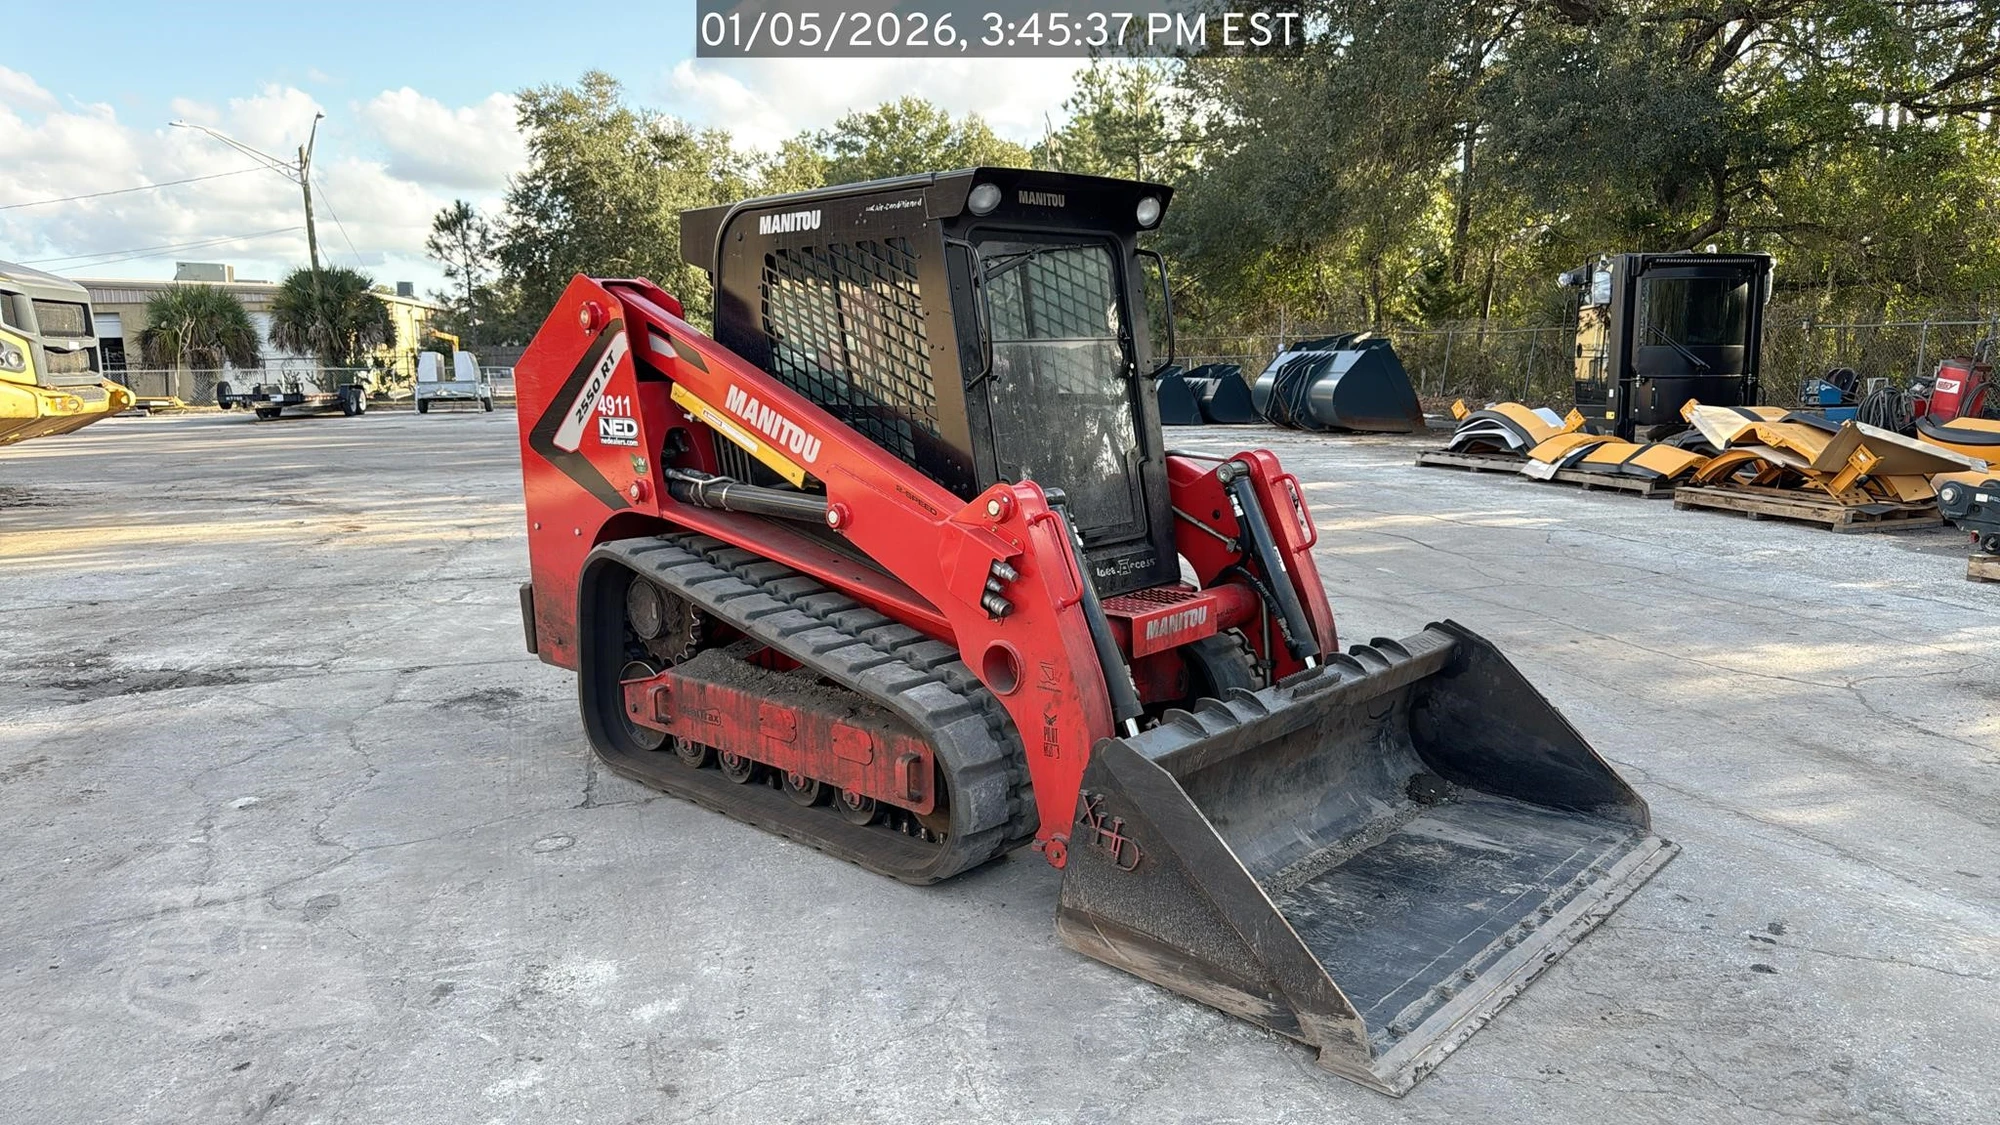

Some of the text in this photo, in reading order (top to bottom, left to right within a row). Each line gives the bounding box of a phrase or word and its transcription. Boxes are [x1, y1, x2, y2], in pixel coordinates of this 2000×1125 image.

[1018, 190, 1065, 208] MANITOU
[759, 210, 822, 235] MANITOU
[575, 349, 615, 424] 2550 RT
[597, 394, 631, 417] 4911
[599, 417, 639, 438] NED
[725, 383, 823, 464] MANITOU
[1146, 605, 1208, 641] MANITOU
